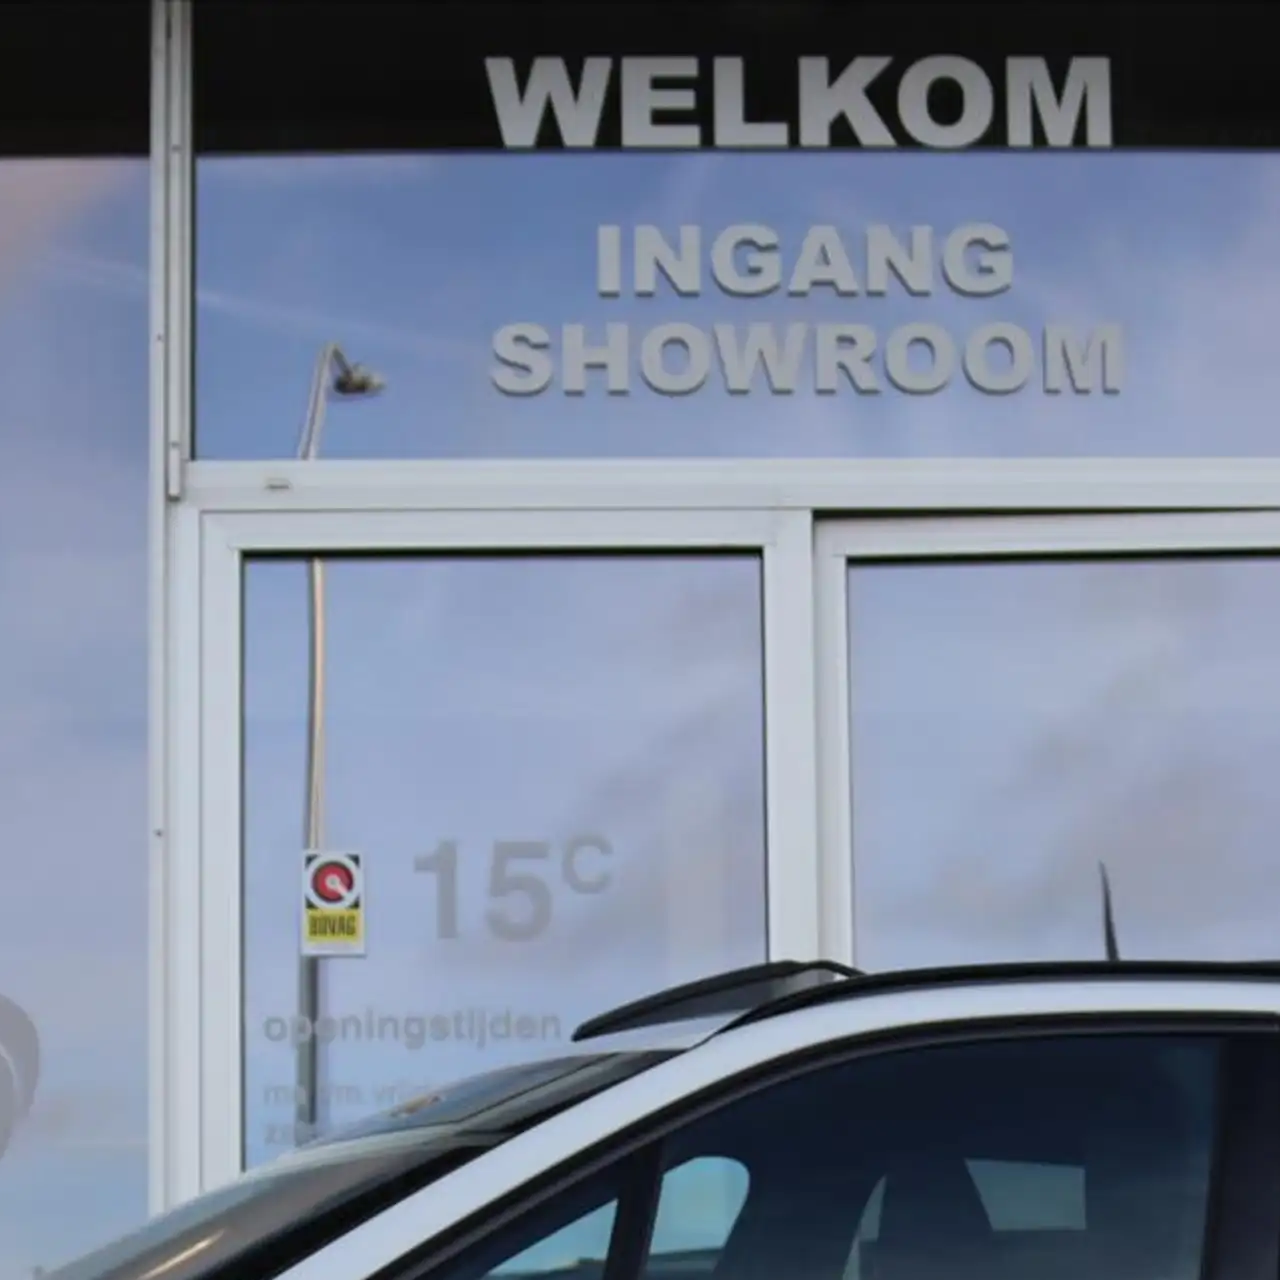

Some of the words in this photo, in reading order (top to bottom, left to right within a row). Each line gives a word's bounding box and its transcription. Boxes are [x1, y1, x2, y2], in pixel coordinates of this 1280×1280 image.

[486, 56, 1113, 150] WELKOM
[598, 223, 1013, 297] INGANG
[492, 322, 1123, 396] SHOWROOM
[309, 915, 356, 937] BOVAG
[264, 1010, 561, 1049] openingstijden
